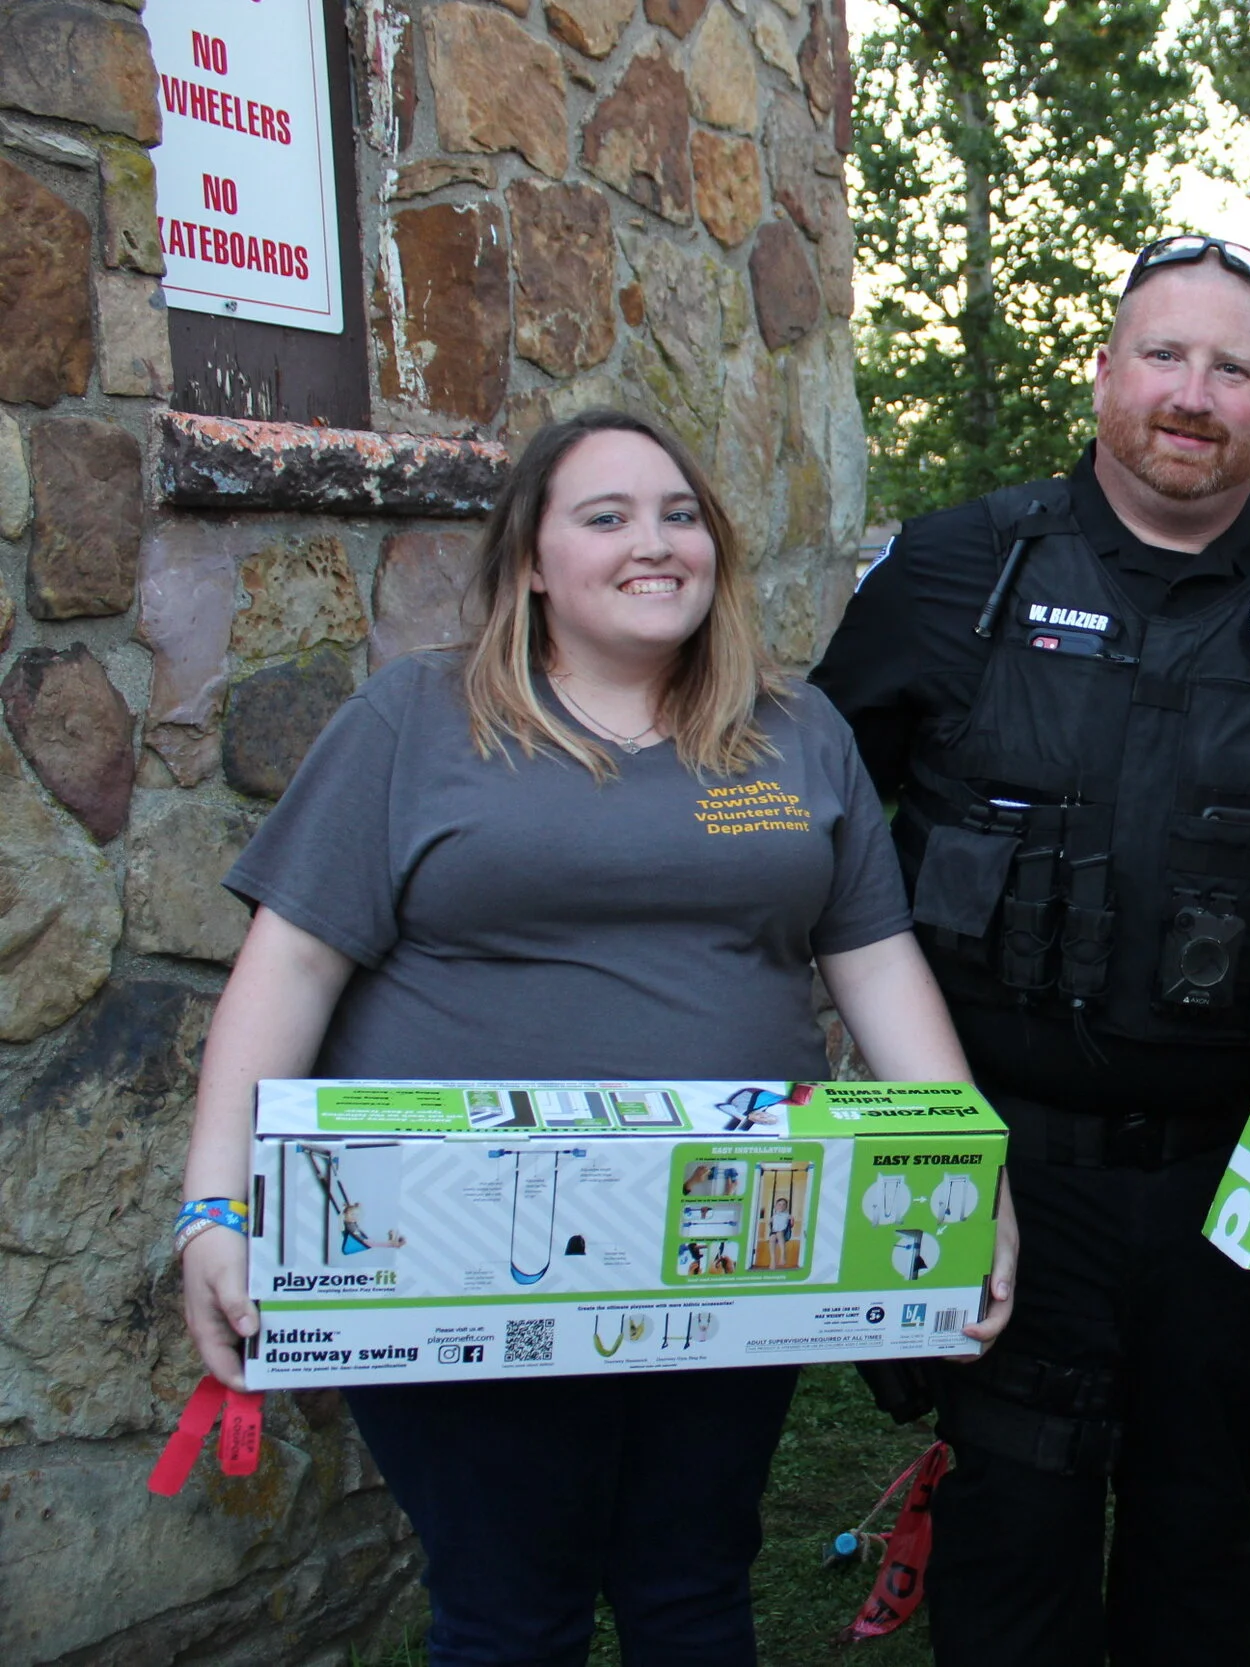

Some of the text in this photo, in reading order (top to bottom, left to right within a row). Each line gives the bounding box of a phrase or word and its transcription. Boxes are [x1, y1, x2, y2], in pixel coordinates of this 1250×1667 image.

[192, 30, 228, 76] NO
[161, 73, 292, 146] WHEELERS
[202, 172, 238, 216] NO
[1029, 603, 1109, 632] W. BLAZIER
[707, 780, 781, 798] Wright
[696, 792, 800, 810] Township
[694, 805, 811, 822] Volunteer Fire
[706, 820, 810, 836] Department
[825, 1088, 963, 1097] doorway swing
[873, 1154, 983, 1166] EASY STORAGE!
[272, 1270, 397, 1293] playzone-fit
[266, 1328, 334, 1345] kidtrix
[427, 1334, 495, 1345] playzonefit.com
[768, 1337, 809, 1345] SUPERVISION
[810, 1336, 842, 1344] REQUIRED
[266, 1345, 419, 1365] doorway swing
[230, 1416, 242, 1461] COUPON
